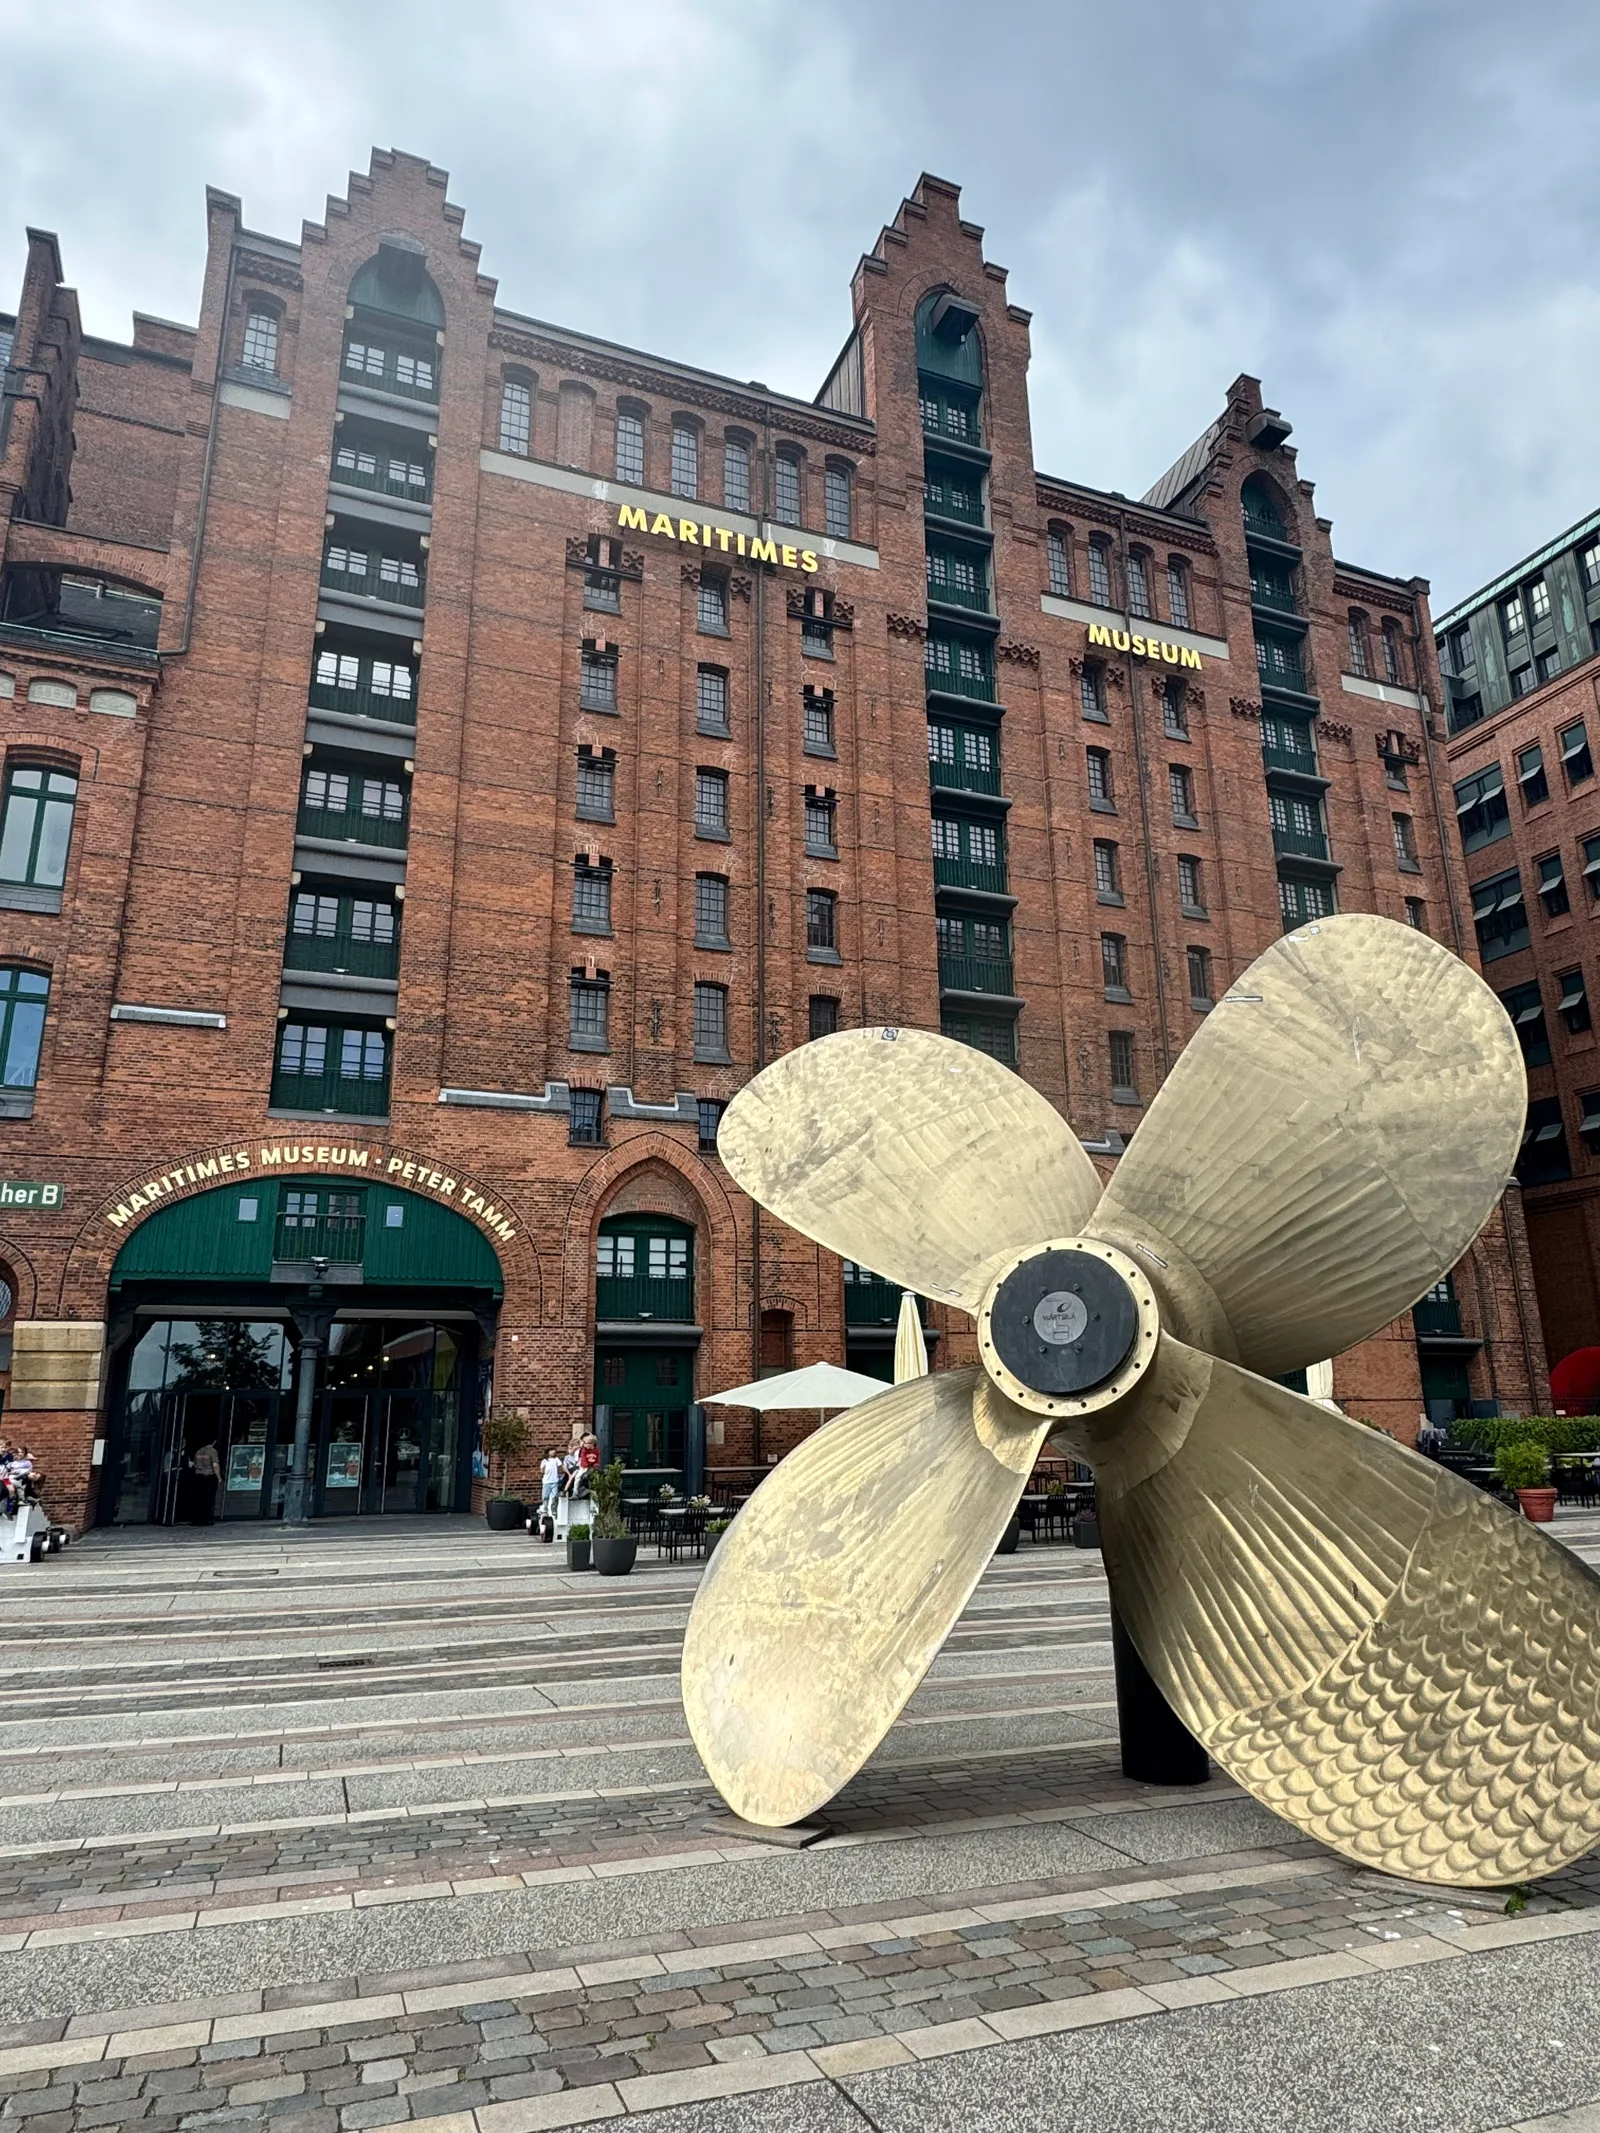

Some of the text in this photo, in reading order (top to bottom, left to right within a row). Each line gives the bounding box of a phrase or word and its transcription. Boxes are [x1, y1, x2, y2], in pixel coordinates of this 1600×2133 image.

[618, 504, 1202, 670] MARITIMES MUSEUM
[1, 1182, 58, 1205] her B
[107, 1146, 516, 1242] MARITIMES MUSEUM PETER TAMM
